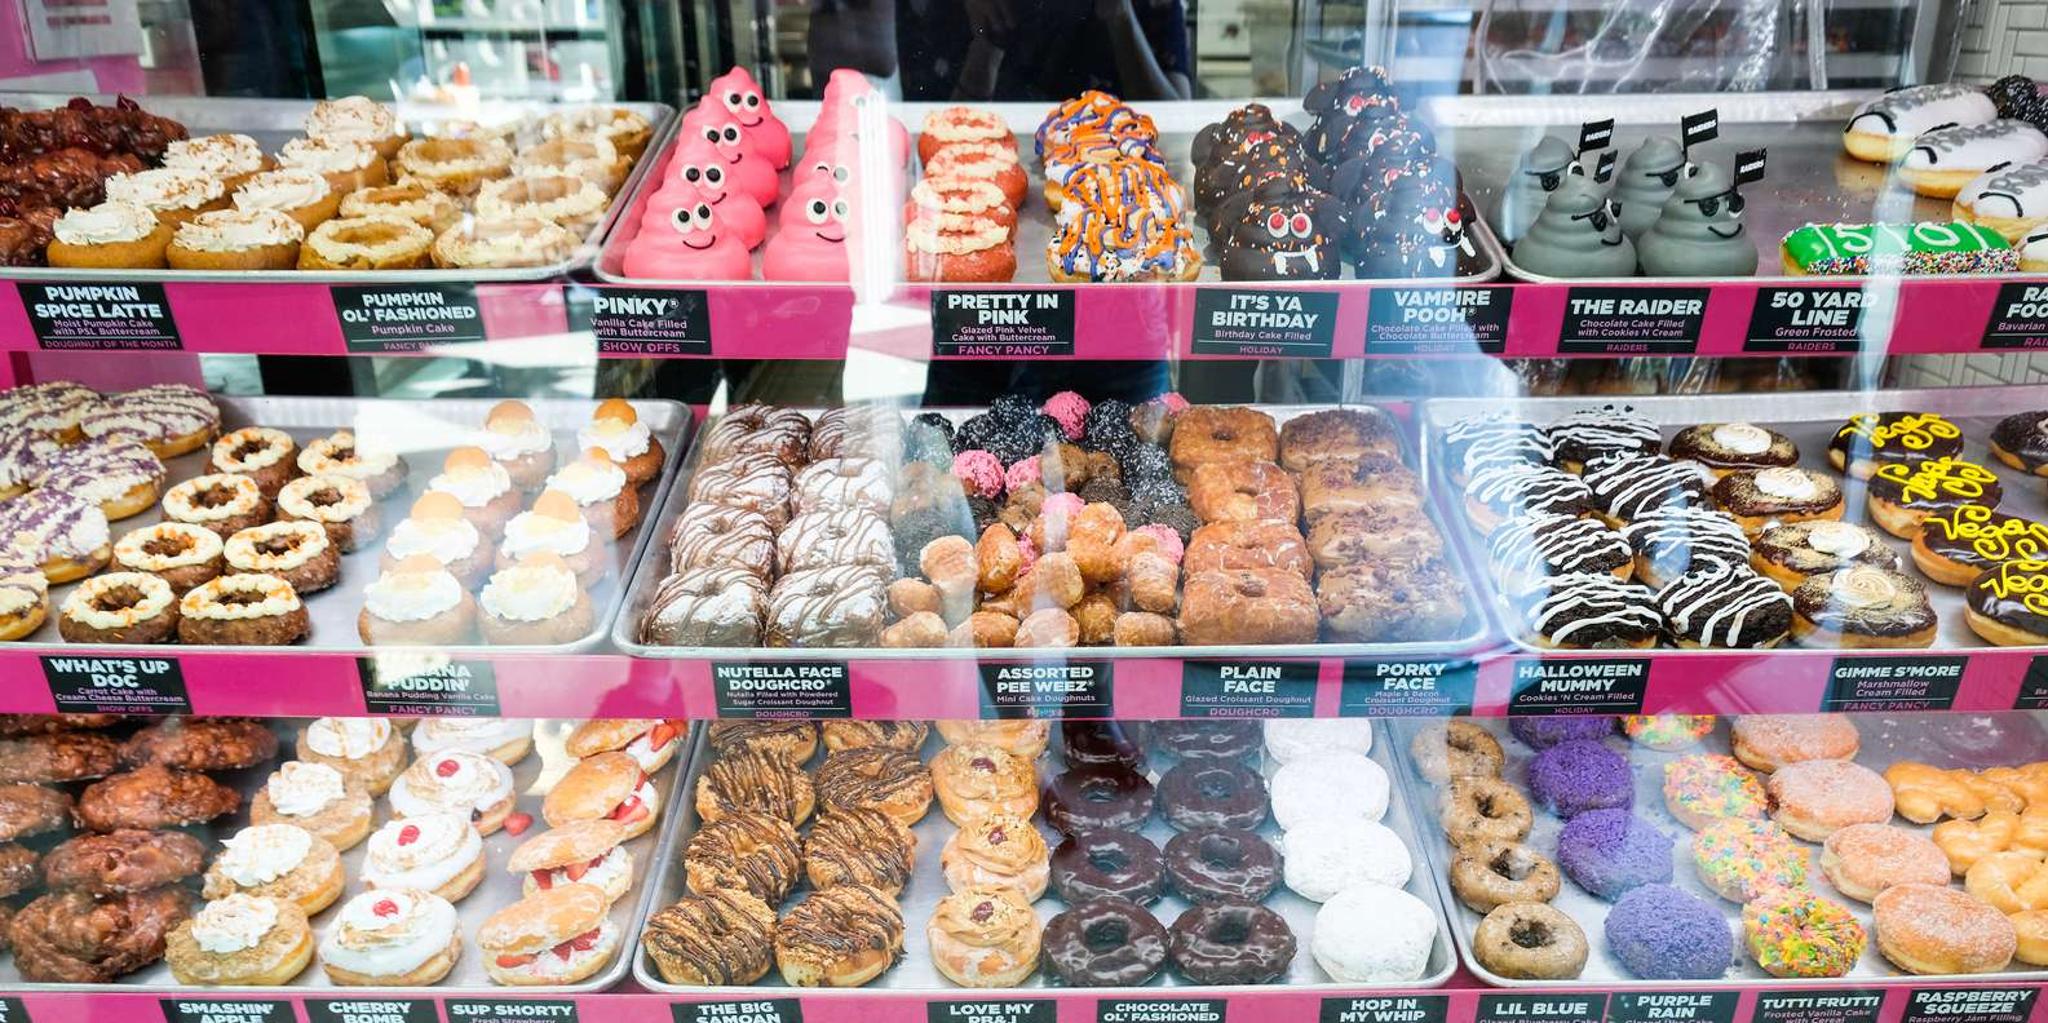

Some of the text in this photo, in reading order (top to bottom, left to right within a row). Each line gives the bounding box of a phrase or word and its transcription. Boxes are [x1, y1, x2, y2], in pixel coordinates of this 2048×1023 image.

[45, 287, 140, 300] PUMPKIN
[1394, 291, 1491, 306] VAMPIRE
[362, 292, 443, 307] PUMPKIN
[948, 294, 1058, 309] PRETTY IN
[1230, 295, 1302, 311] IT'S YA
[1770, 292, 1878, 308] 50 YARD
[35, 304, 163, 318] SPICE LATTE
[1570, 300, 1703, 315] THE RAIDER
[342, 306, 476, 322] OL' FASHIONED
[978, 310, 1029, 324] PINK
[1791, 310, 1849, 325] LINE
[83, 320, 127, 329] Pumpkin
[590, 319, 687, 329] Vanilla Cake Filled
[1212, 312, 1319, 328] BIRTHDAY
[1580, 320, 1685, 328] Chocolate Cake Filled
[371, 324, 455, 335] Pumpkin Cake
[620, 328, 686, 338] Buttercream
[1215, 330, 1255, 339] Birthday
[1284, 332, 1311, 340] Filled
[1776, 327, 1858, 337] Green Frosted
[603, 342, 680, 352] SHOW OFFS
[959, 346, 1049, 354] FANCY PANCY
[1240, 346, 1284, 354] HOLIDAY
[49, 659, 170, 674] WHAT'S UP
[1376, 664, 1446, 676] PORKY
[1519, 665, 1642, 678] HALLOWEEN
[1835, 666, 1961, 678] GIMME S'MORE
[718, 668, 842, 678] NUTELLA FACE
[998, 667, 1093, 679] ASSORTED
[1221, 667, 1281, 679] PLAIN
[92, 674, 139, 687] DOC
[1384, 678, 1435, 690] FACE
[1540, 679, 1616, 692] MUMMY
[997, 682, 1030, 693] PEE
[1224, 681, 1276, 693] FACE
[1045, 694, 1095, 702] Doughnuts
[1856, 689, 1892, 697] Cream
[435, 706, 477, 714] PANCY
[1637, 996, 1713, 1006] PURPLE
[1915, 991, 2033, 1003] RASPBERRY
[179, 1003, 274, 1014] SMASHIN'
[328, 1002, 411, 1013] CHERRY
[698, 1002, 774, 1015] THE BIG
[1351, 999, 1417, 1010] HOP IN
[1496, 1003, 1588, 1014] LIL BLUE
[1763, 997, 1880, 1009] TUTTI FRUTTI
[1924, 1003, 2015, 1014] SQUEEZE
[452, 1005, 573, 1015] SUP SHORTY
[950, 1004, 1034, 1015] LOVE MY
[1648, 1008, 1696, 1018] RAIN
[200, 1014, 263, 1023] APPLE
[343, 1014, 405, 1023] BOMB
[696, 1014, 780, 1023] SAMOAN
[1104, 1013, 1219, 1021] OL' FASHIONED
[1340, 1011, 1426, 1022] MY WHIP
